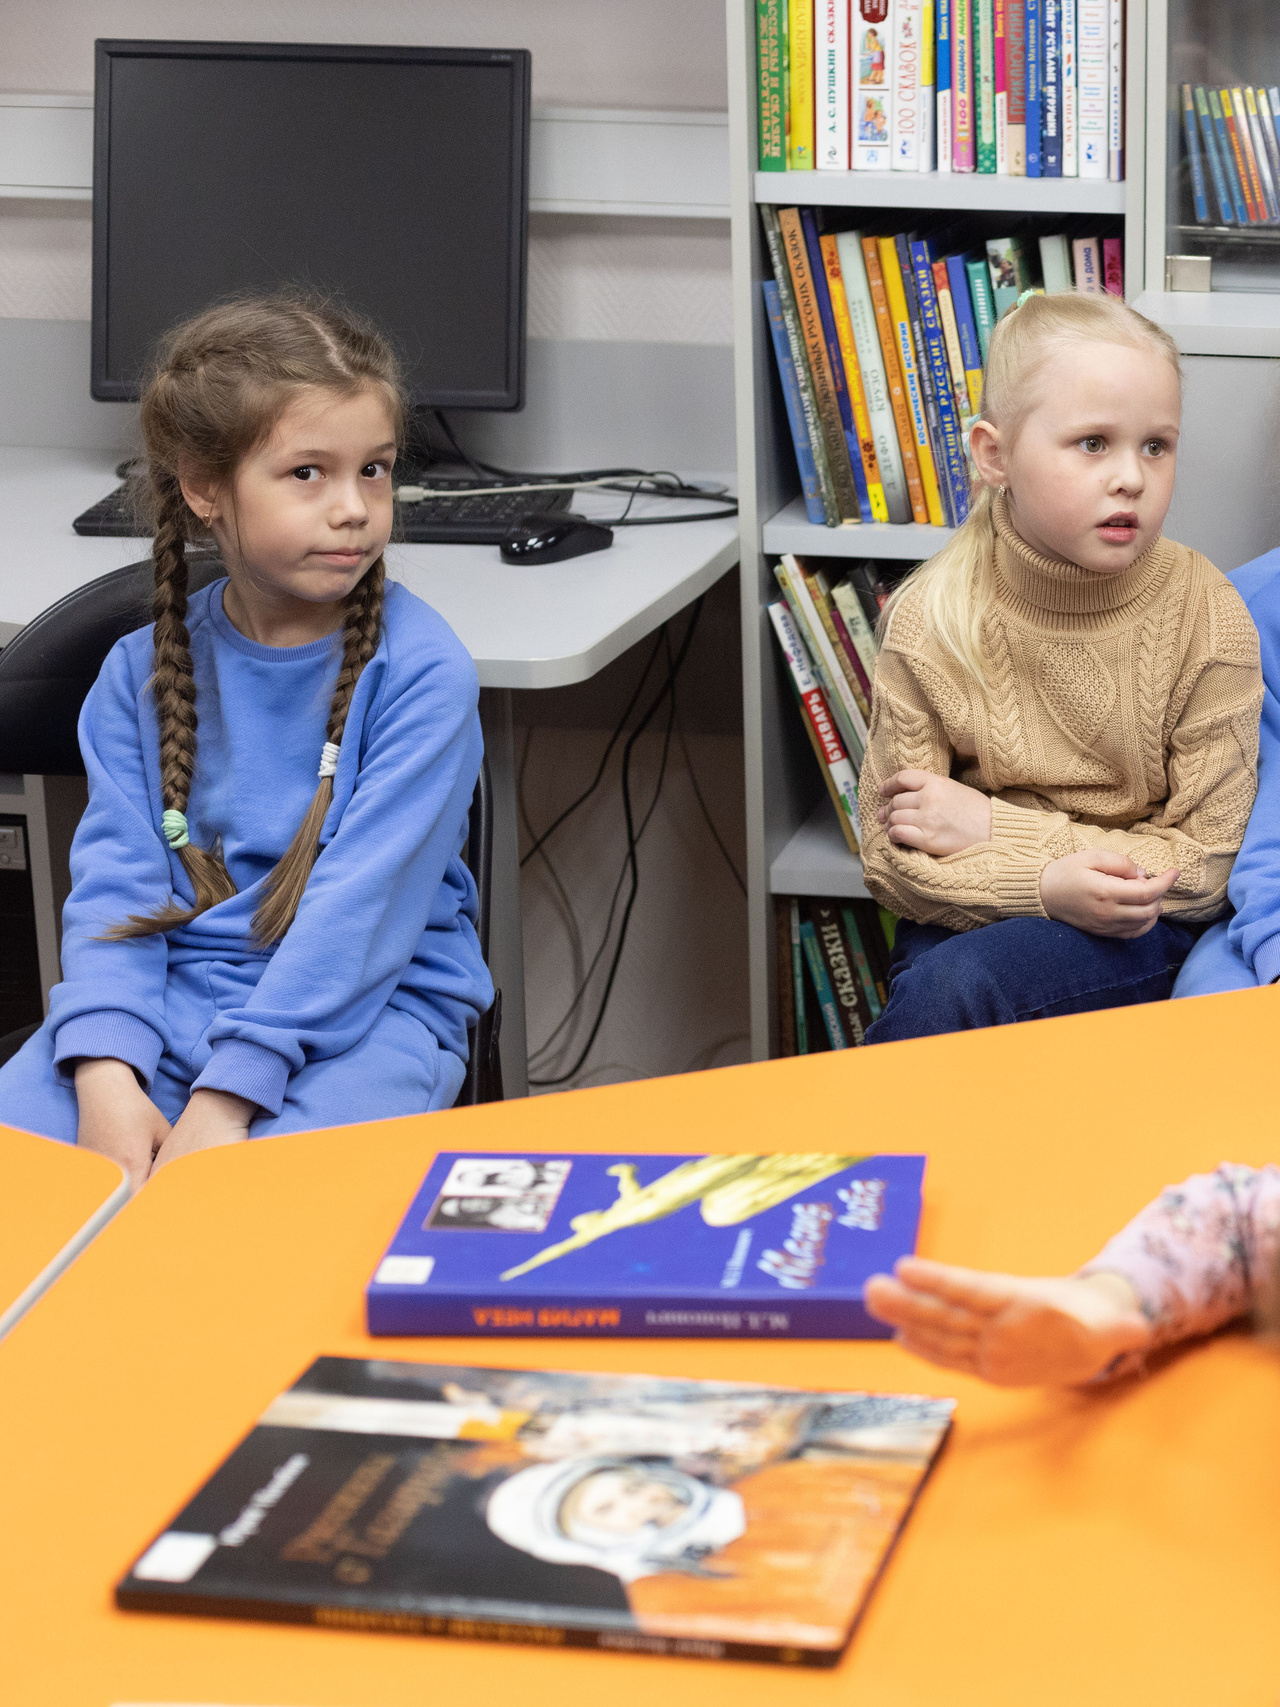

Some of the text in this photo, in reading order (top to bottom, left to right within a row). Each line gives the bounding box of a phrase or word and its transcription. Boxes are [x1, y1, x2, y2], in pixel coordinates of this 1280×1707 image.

[828, 49, 836, 104] ПУШКИН
[1046, 31, 1056, 82] УСТАЛЫЕ
[897, 41, 918, 135] 100 СКАЗОК
[790, 227, 805, 279] СКАЗОК
[1083, 246, 1094, 274] дома
[798, 281, 815, 339] РУССКИХ
[918, 268, 935, 328] СКАЗКИ
[898, 320, 926, 445] КОСМИЧЕСКИЕ ИСТОРИИ
[929, 337, 949, 406] РУССКИЕ
[808, 692, 842, 762] БУКВАРЬ
